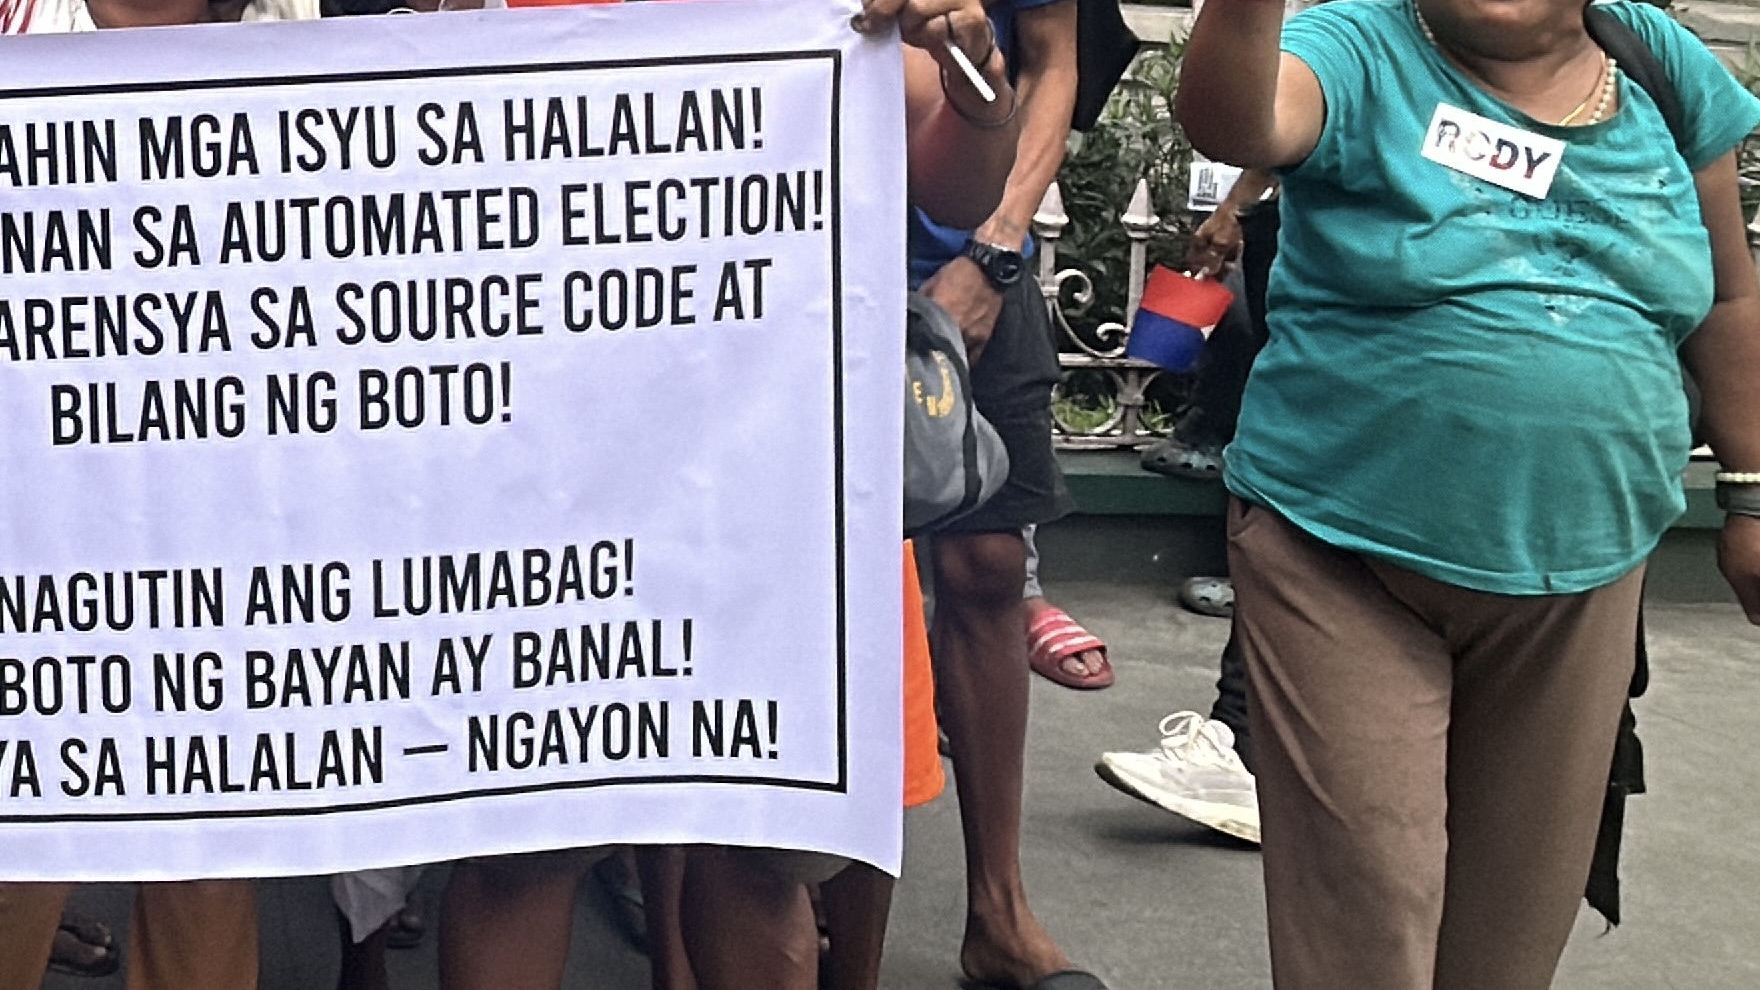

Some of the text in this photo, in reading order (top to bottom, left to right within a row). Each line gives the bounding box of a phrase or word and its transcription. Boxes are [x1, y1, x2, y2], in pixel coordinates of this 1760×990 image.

[139, 113, 259, 180] MGA
[279, 106, 395, 173] ISYU
[417, 102, 483, 165] SA
[504, 87, 764, 162] HALALAN!
[133, 205, 200, 268] SA
[220, 187, 538, 265] AUTOMATED
[562, 171, 823, 246] ELECTION!
[251, 287, 317, 349] SA
[336, 273, 544, 346] SOURCE
[564, 265, 697, 332] CODE
[714, 259, 772, 322] AT
[51, 363, 513, 445] BILANG NG BOTO!
[245, 561, 351, 627] ANG
[373, 538, 635, 618] LUMABAG!
[154, 652, 224, 711] NG
[246, 642, 410, 709] BAYAN
[431, 634, 493, 696] AY
[513, 619, 693, 689] BANAL!
[60, 738, 126, 797] SA
[145, 726, 383, 795] HALALAN
[468, 701, 669, 774] NGAYON
[692, 700, 780, 761] NA!
